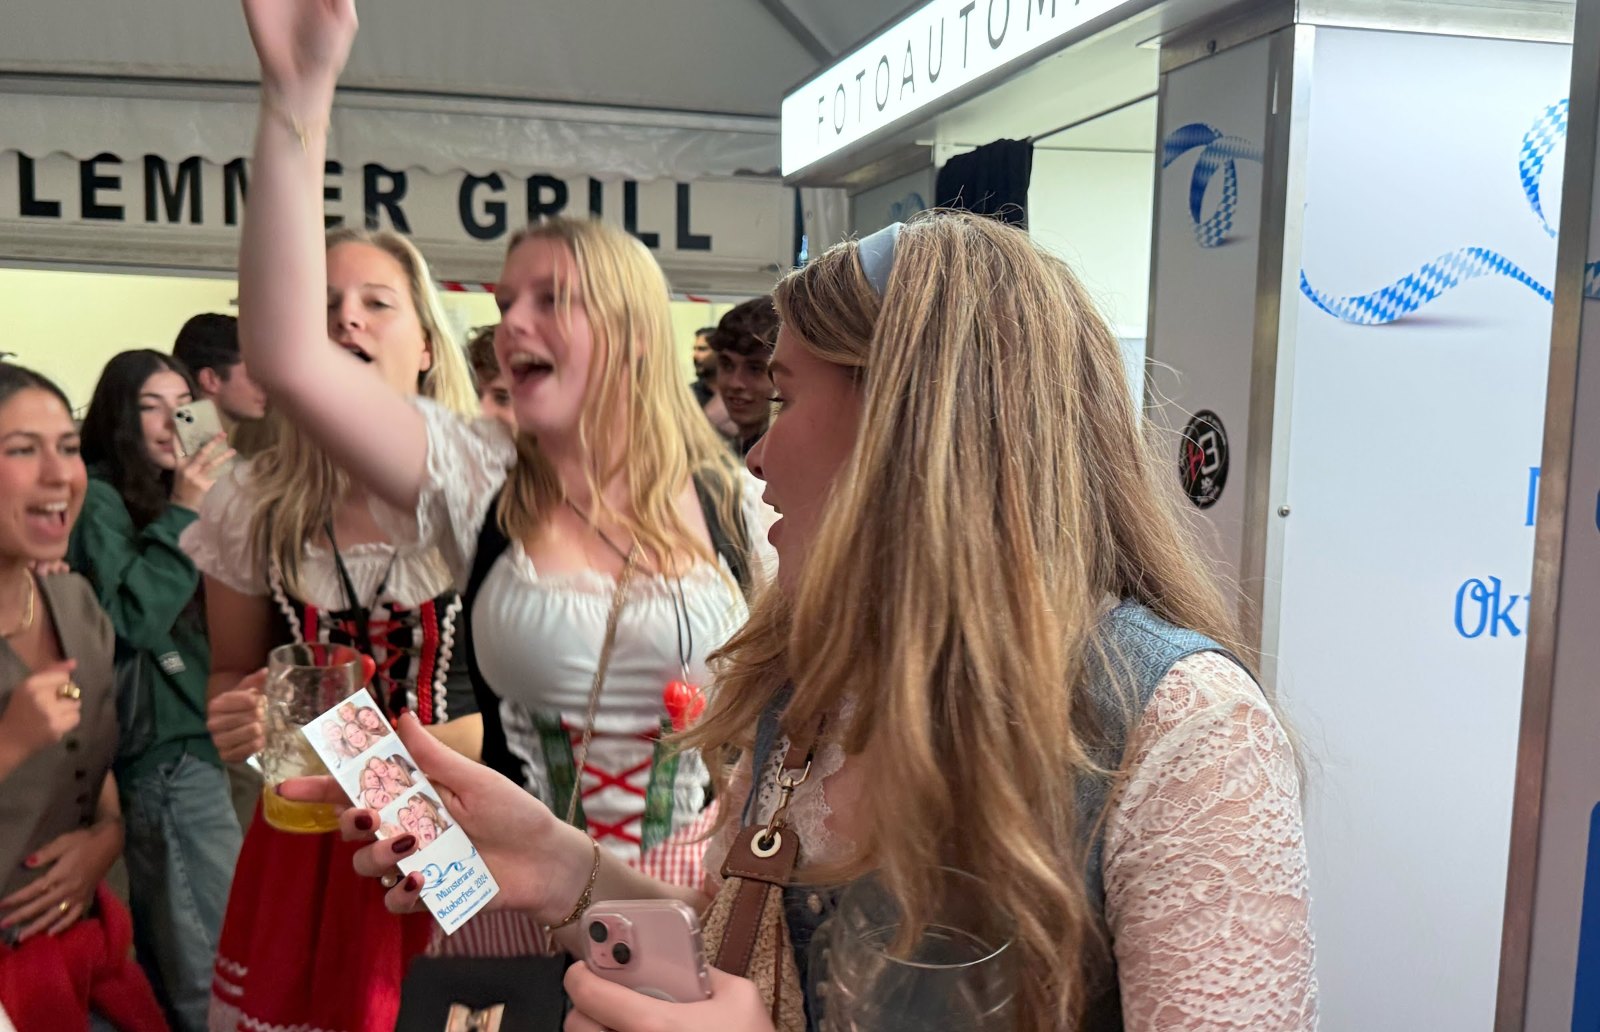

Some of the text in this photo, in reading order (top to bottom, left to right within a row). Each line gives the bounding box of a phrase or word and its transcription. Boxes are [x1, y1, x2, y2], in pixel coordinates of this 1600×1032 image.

[817, 0, 1080, 145] FOTOAUTO
[459, 171, 712, 251] GRILL
[1454, 575, 1531, 639] Ok
[437, 886, 476, 919] Oktoberfest
